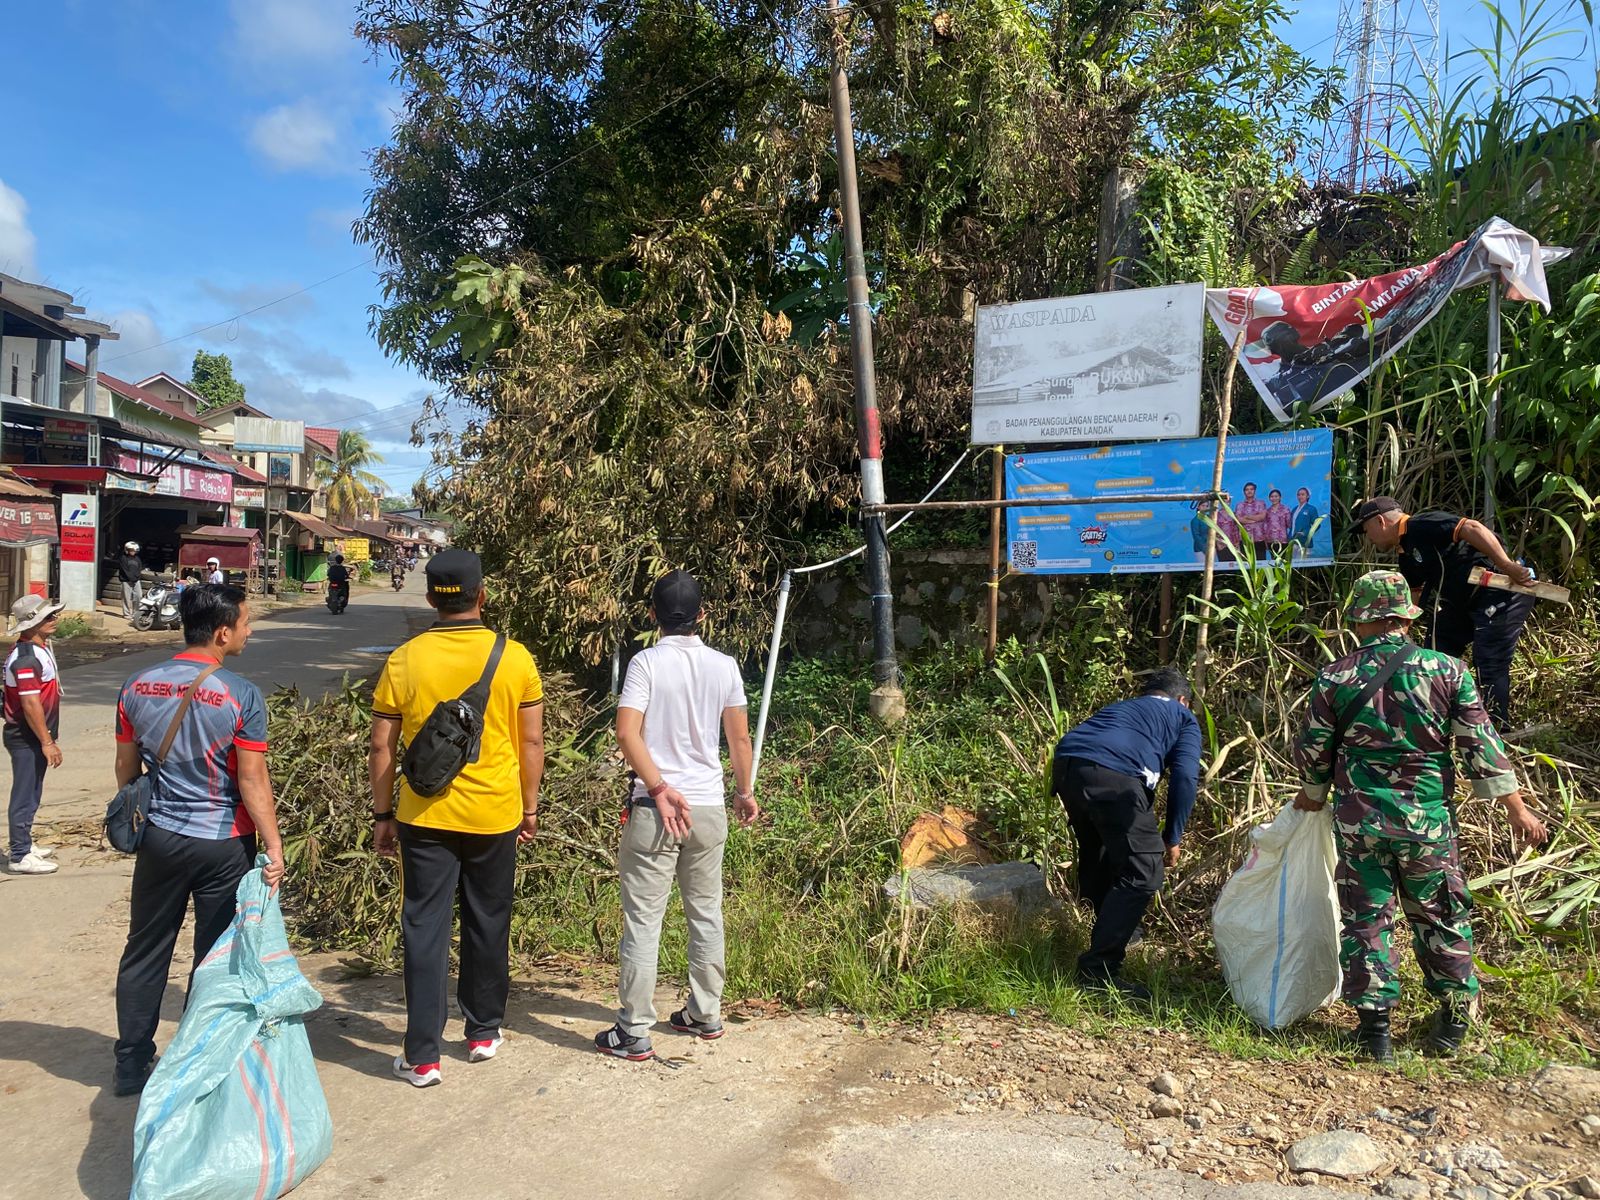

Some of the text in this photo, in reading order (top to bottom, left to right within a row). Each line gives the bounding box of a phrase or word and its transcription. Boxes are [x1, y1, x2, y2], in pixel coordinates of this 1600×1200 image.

[990, 305, 1096, 331] WASPADA
[1005, 412, 1159, 429] BADAN PENANGGULANGAN BENCANA DAERAH
[1040, 425, 1115, 437] KABUPATEN LANDAK
[235, 489, 263, 498] Canon
[19, 511, 32, 525] 16
[1080, 530, 1106, 542] GRATIS!
[134, 681, 225, 708] POLSEK MYUKE
